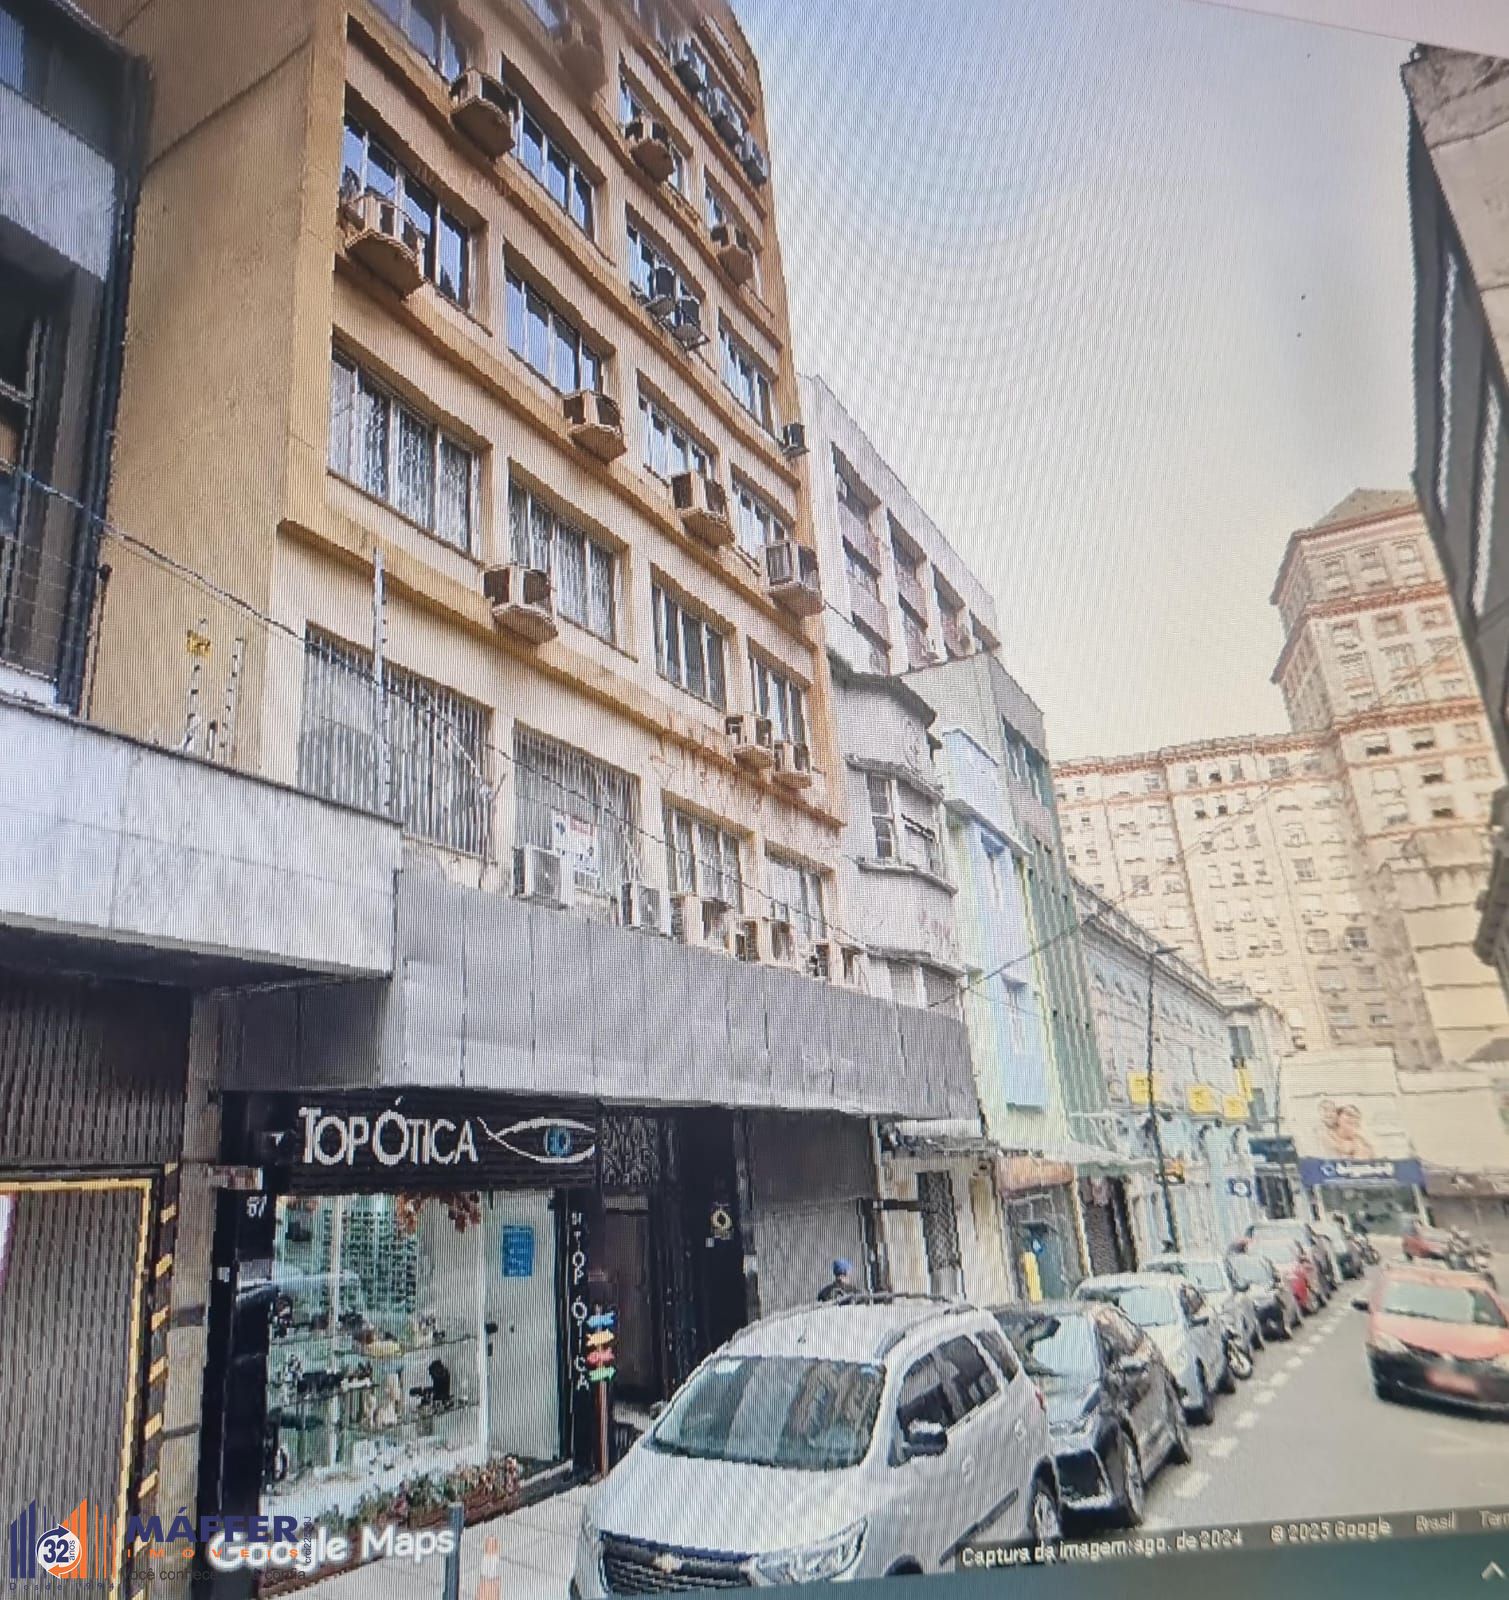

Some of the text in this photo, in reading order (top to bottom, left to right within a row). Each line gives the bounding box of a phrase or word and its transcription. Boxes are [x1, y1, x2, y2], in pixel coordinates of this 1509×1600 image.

[1334, 1514, 1392, 1543] Google
[1415, 1511, 1457, 1533] Brasil
[208, 1524, 456, 1574] Google Maps
[962, 1545, 1030, 1569] Captura
[1034, 1541, 1056, 1562] da
[1175, 1529, 1198, 1552] de
[1200, 1528, 1243, 1549] 2024
